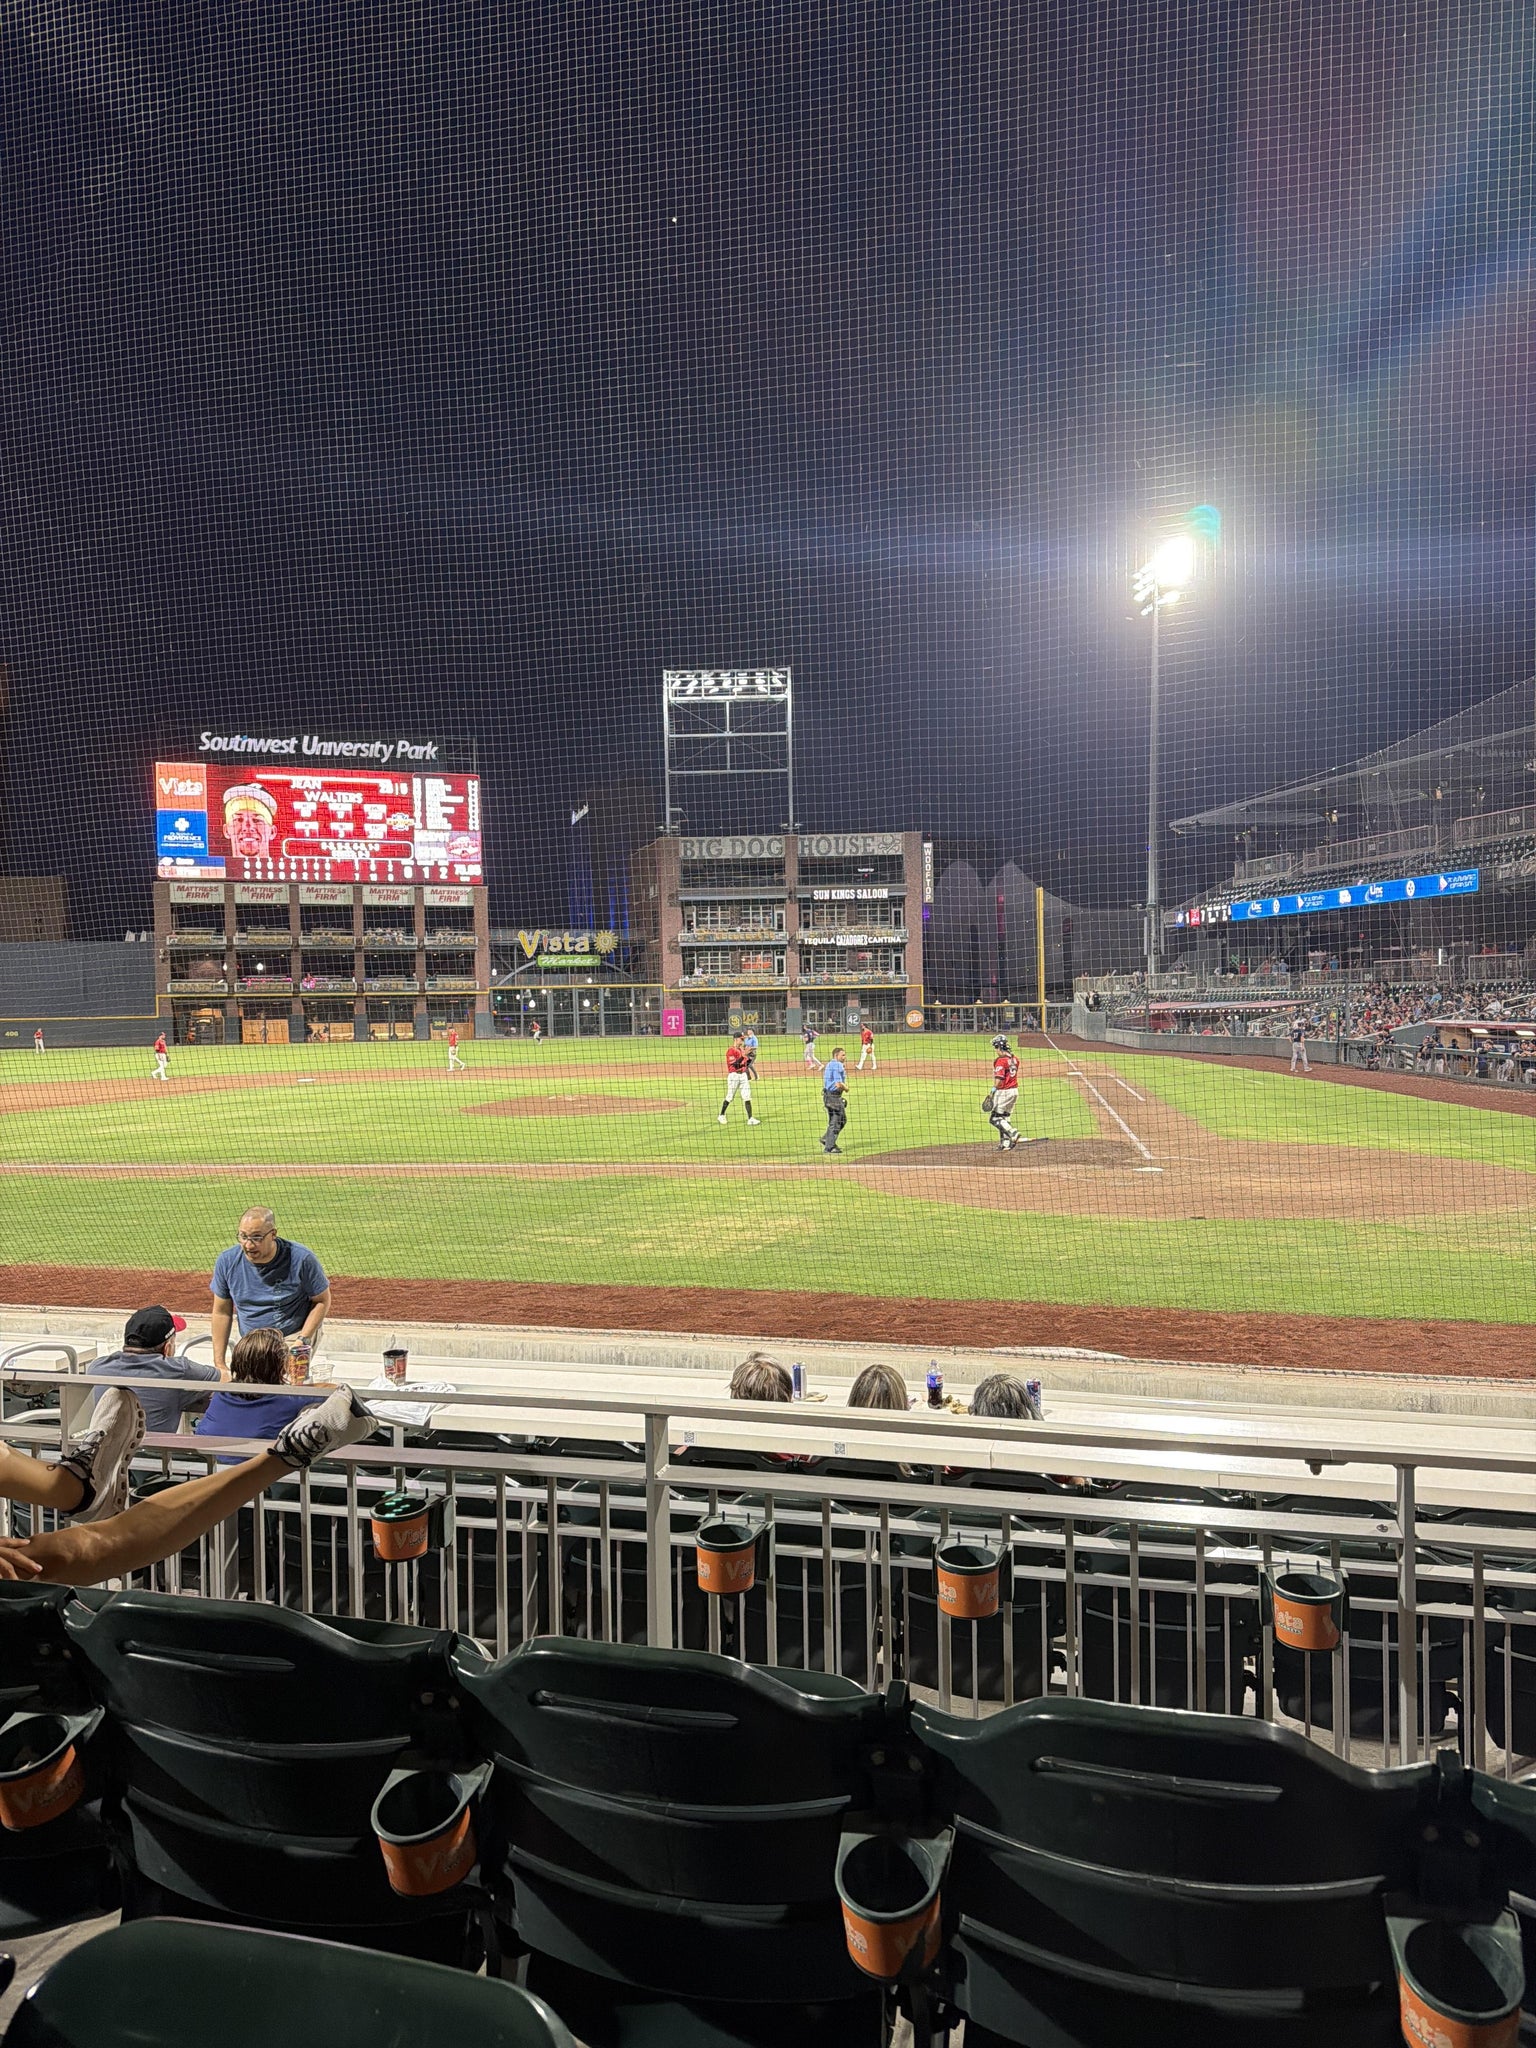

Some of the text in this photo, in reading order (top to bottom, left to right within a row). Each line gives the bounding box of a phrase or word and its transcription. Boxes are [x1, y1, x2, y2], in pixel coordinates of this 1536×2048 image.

[199, 732, 439, 763] Southwest University Park
[303, 790, 363, 803] WALTERS
[680, 834, 875, 859] BIG DOG HOUSE
[924, 848, 932, 903] WOOFTOP
[305, 886, 347, 894] MATTRESS
[369, 887, 408, 895] MATTRESS
[430, 888, 468, 896] MATTRESS
[813, 888, 889, 900] SUN KINGS SALOON
[518, 930, 590, 958] Vista
[804, 937, 836, 945] TEQUILA
[836, 934, 868, 946] CAZADORES
[848, 1015, 859, 1024] 42
